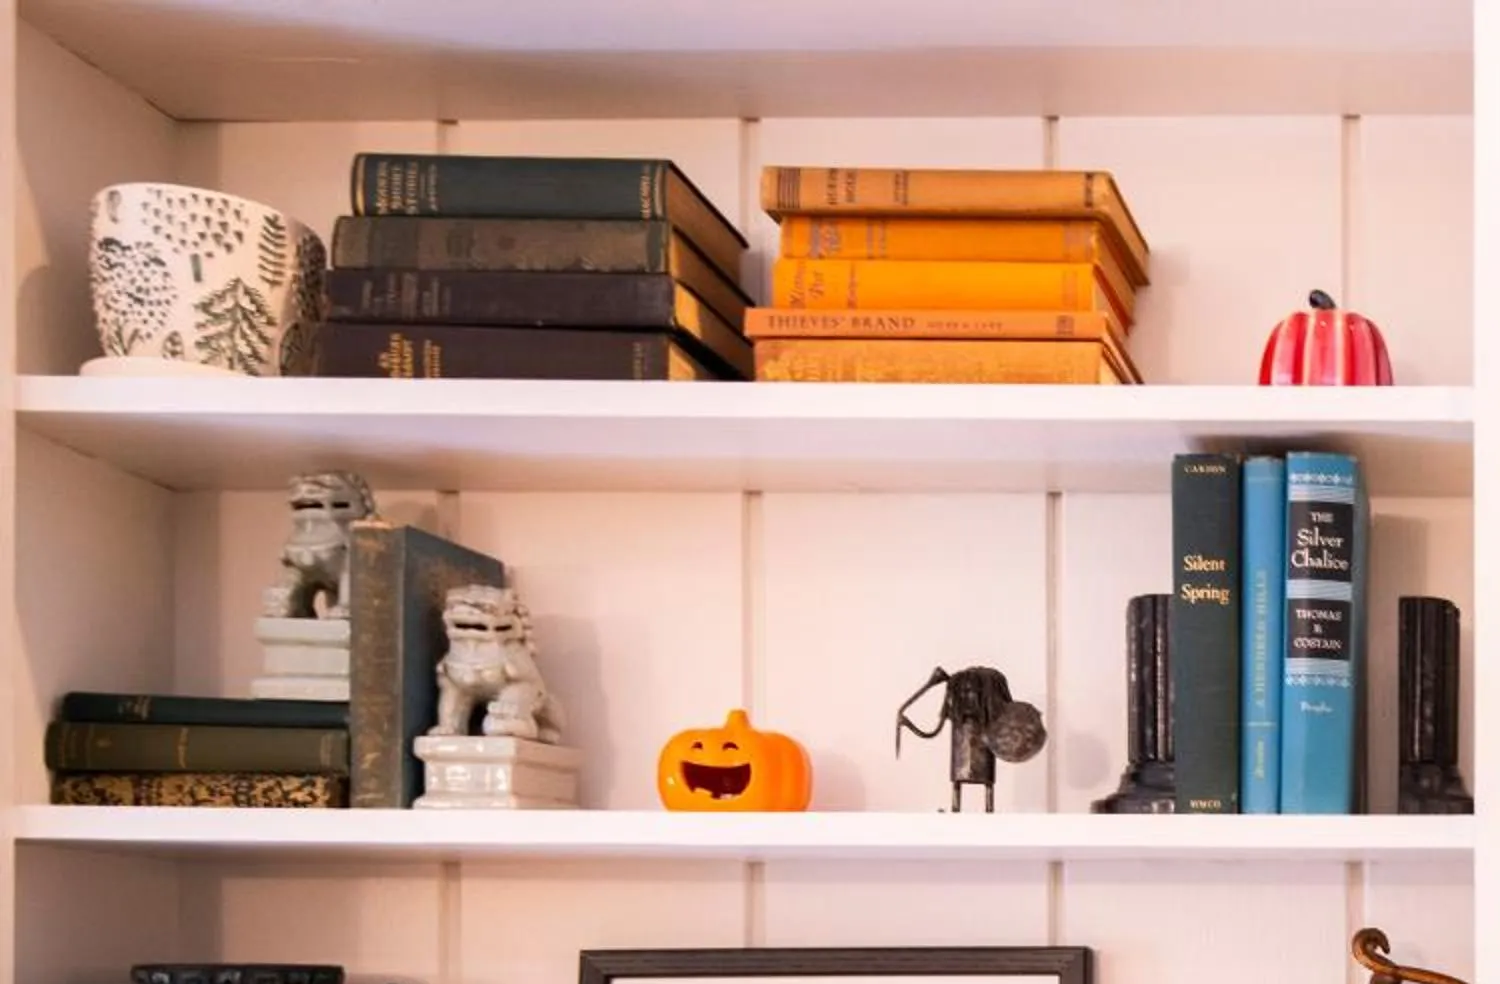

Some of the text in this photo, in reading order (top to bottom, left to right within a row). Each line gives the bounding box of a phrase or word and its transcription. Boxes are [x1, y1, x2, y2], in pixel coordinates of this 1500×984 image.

[851, 316, 915, 331] BRAND
[1310, 511, 1334, 524] THE
[1296, 526, 1344, 548] Silver
[1183, 554, 1225, 572] Silent
[1291, 550, 1350, 571] Chalice
[1181, 583, 1231, 605] Spring
[1295, 609, 1342, 621] THOMAS
[1293, 637, 1342, 649] COSTAIN
